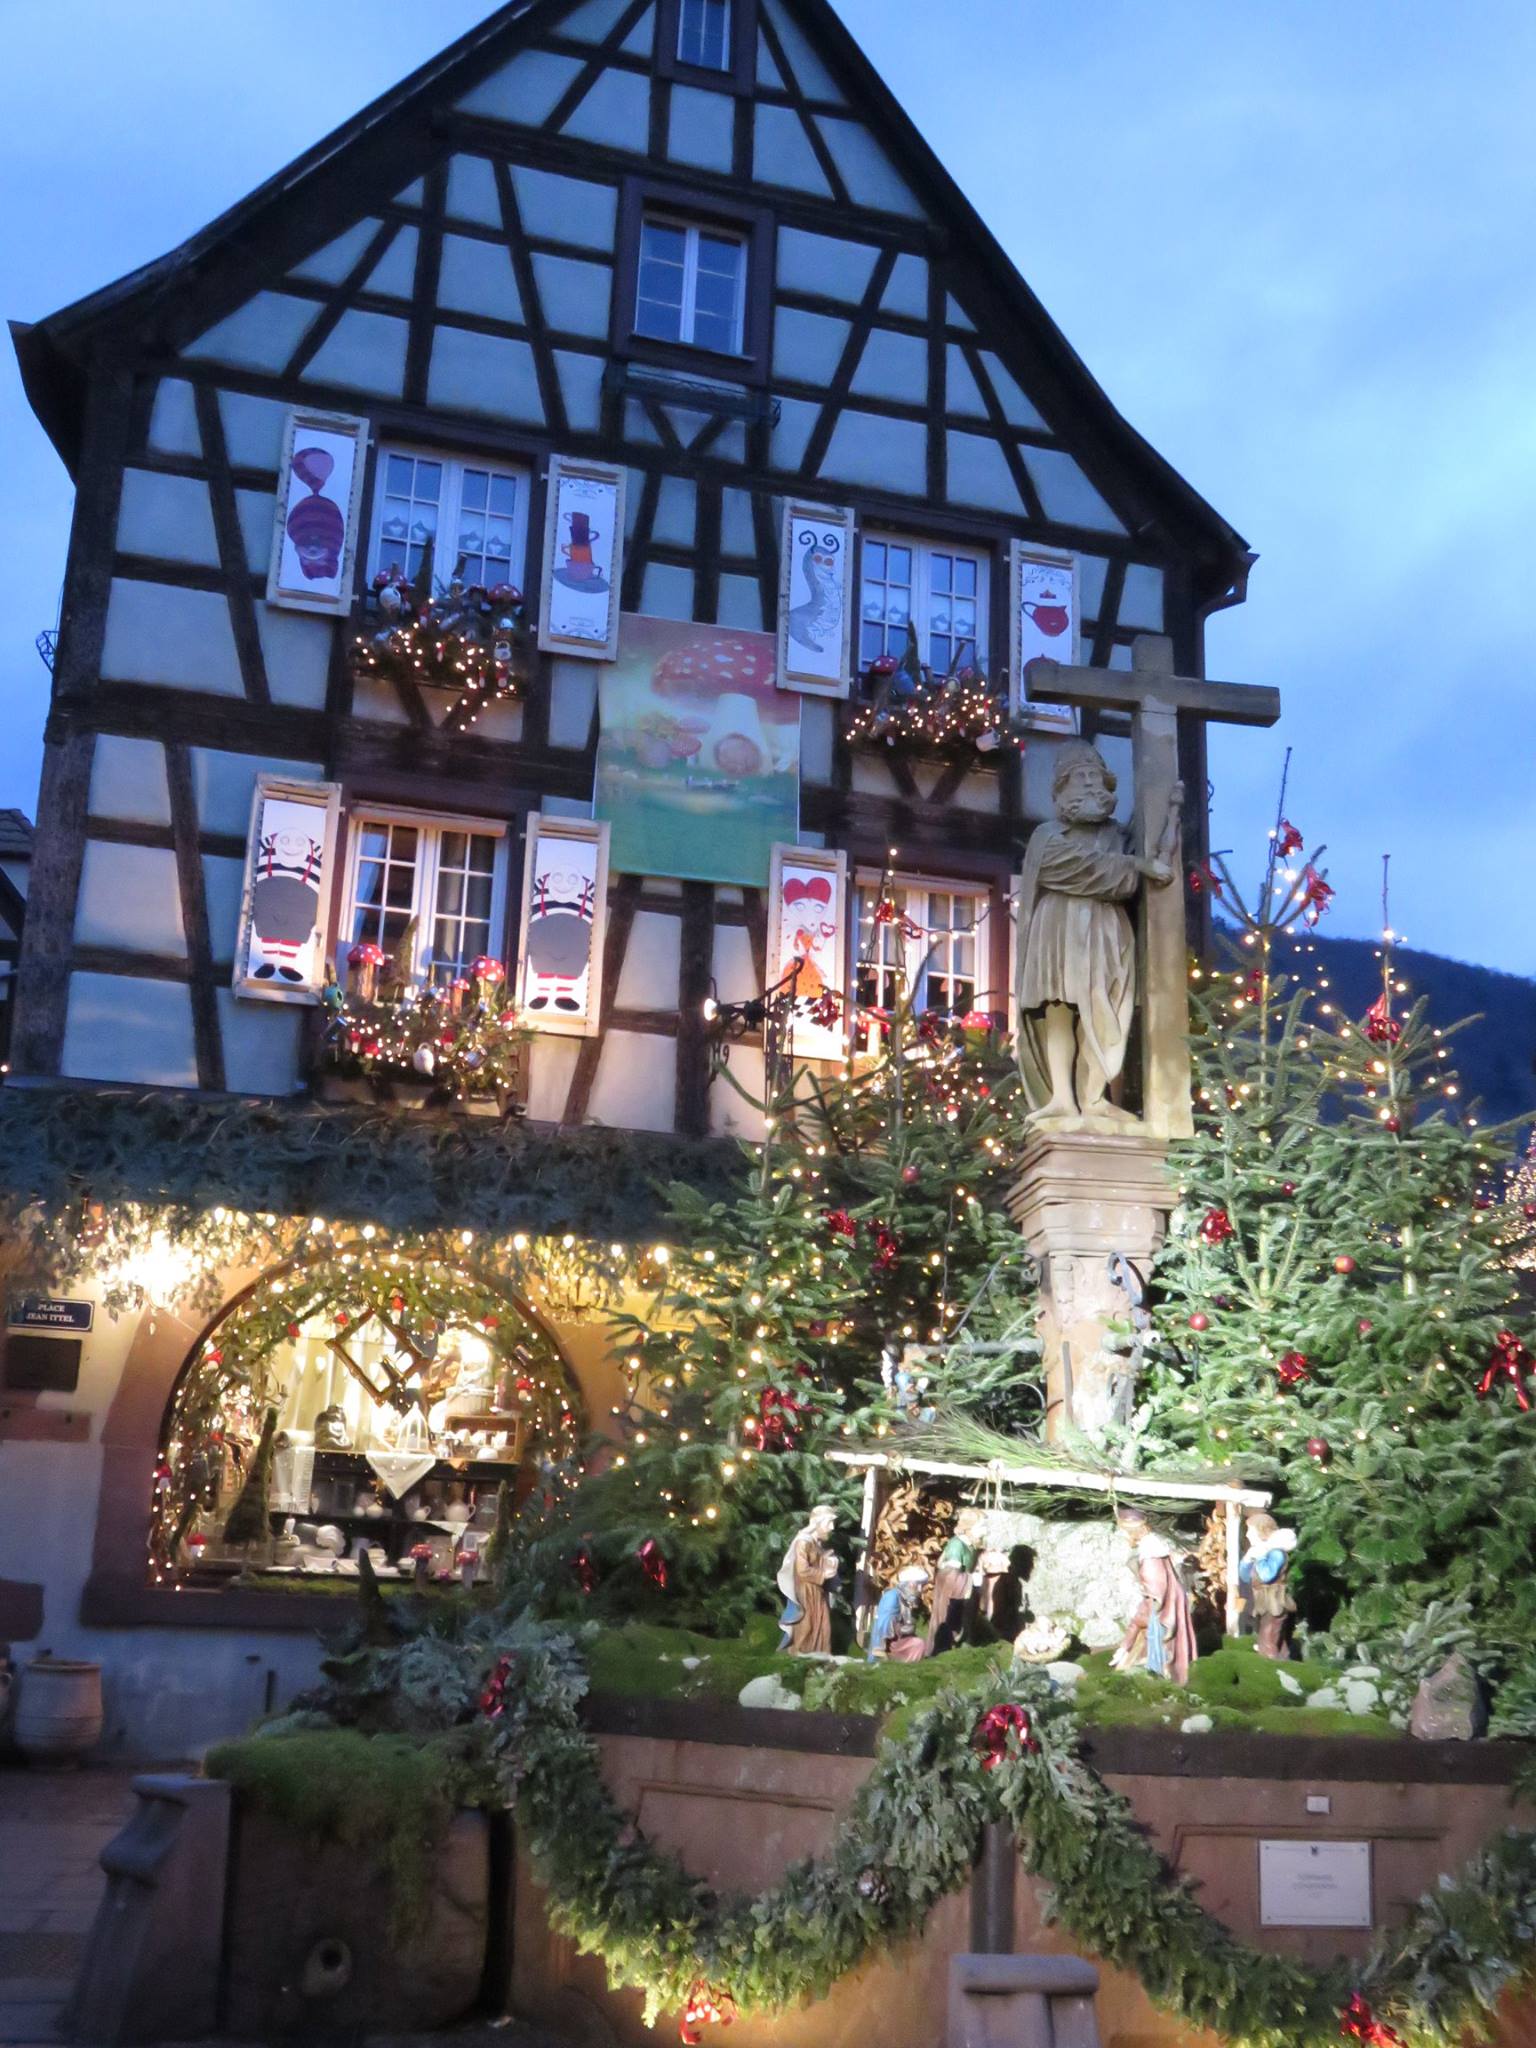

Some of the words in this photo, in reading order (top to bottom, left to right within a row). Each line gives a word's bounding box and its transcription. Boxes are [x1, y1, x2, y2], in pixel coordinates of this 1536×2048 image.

[38, 1304, 65, 1312] PLACE
[26, 1313, 48, 1321] JEAN
[49, 1314, 74, 1323] ITTEL
